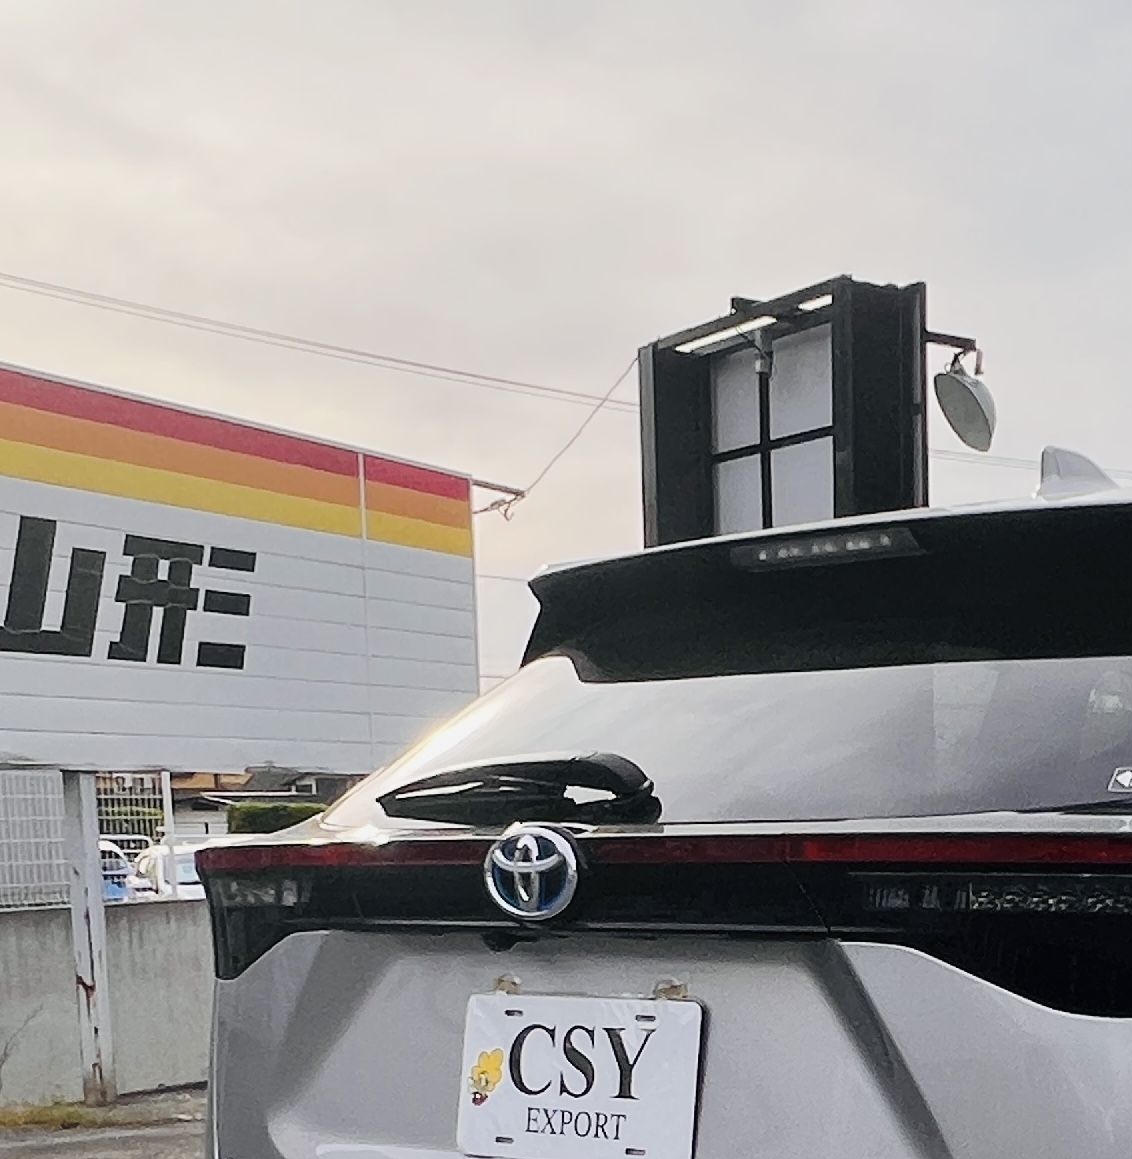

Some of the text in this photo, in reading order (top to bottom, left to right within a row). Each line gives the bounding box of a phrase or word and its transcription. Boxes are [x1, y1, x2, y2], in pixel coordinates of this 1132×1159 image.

[0, 515, 257, 670] 山形
[509, 1024, 656, 1100] CSY
[525, 1107, 627, 1140] EXPORT
